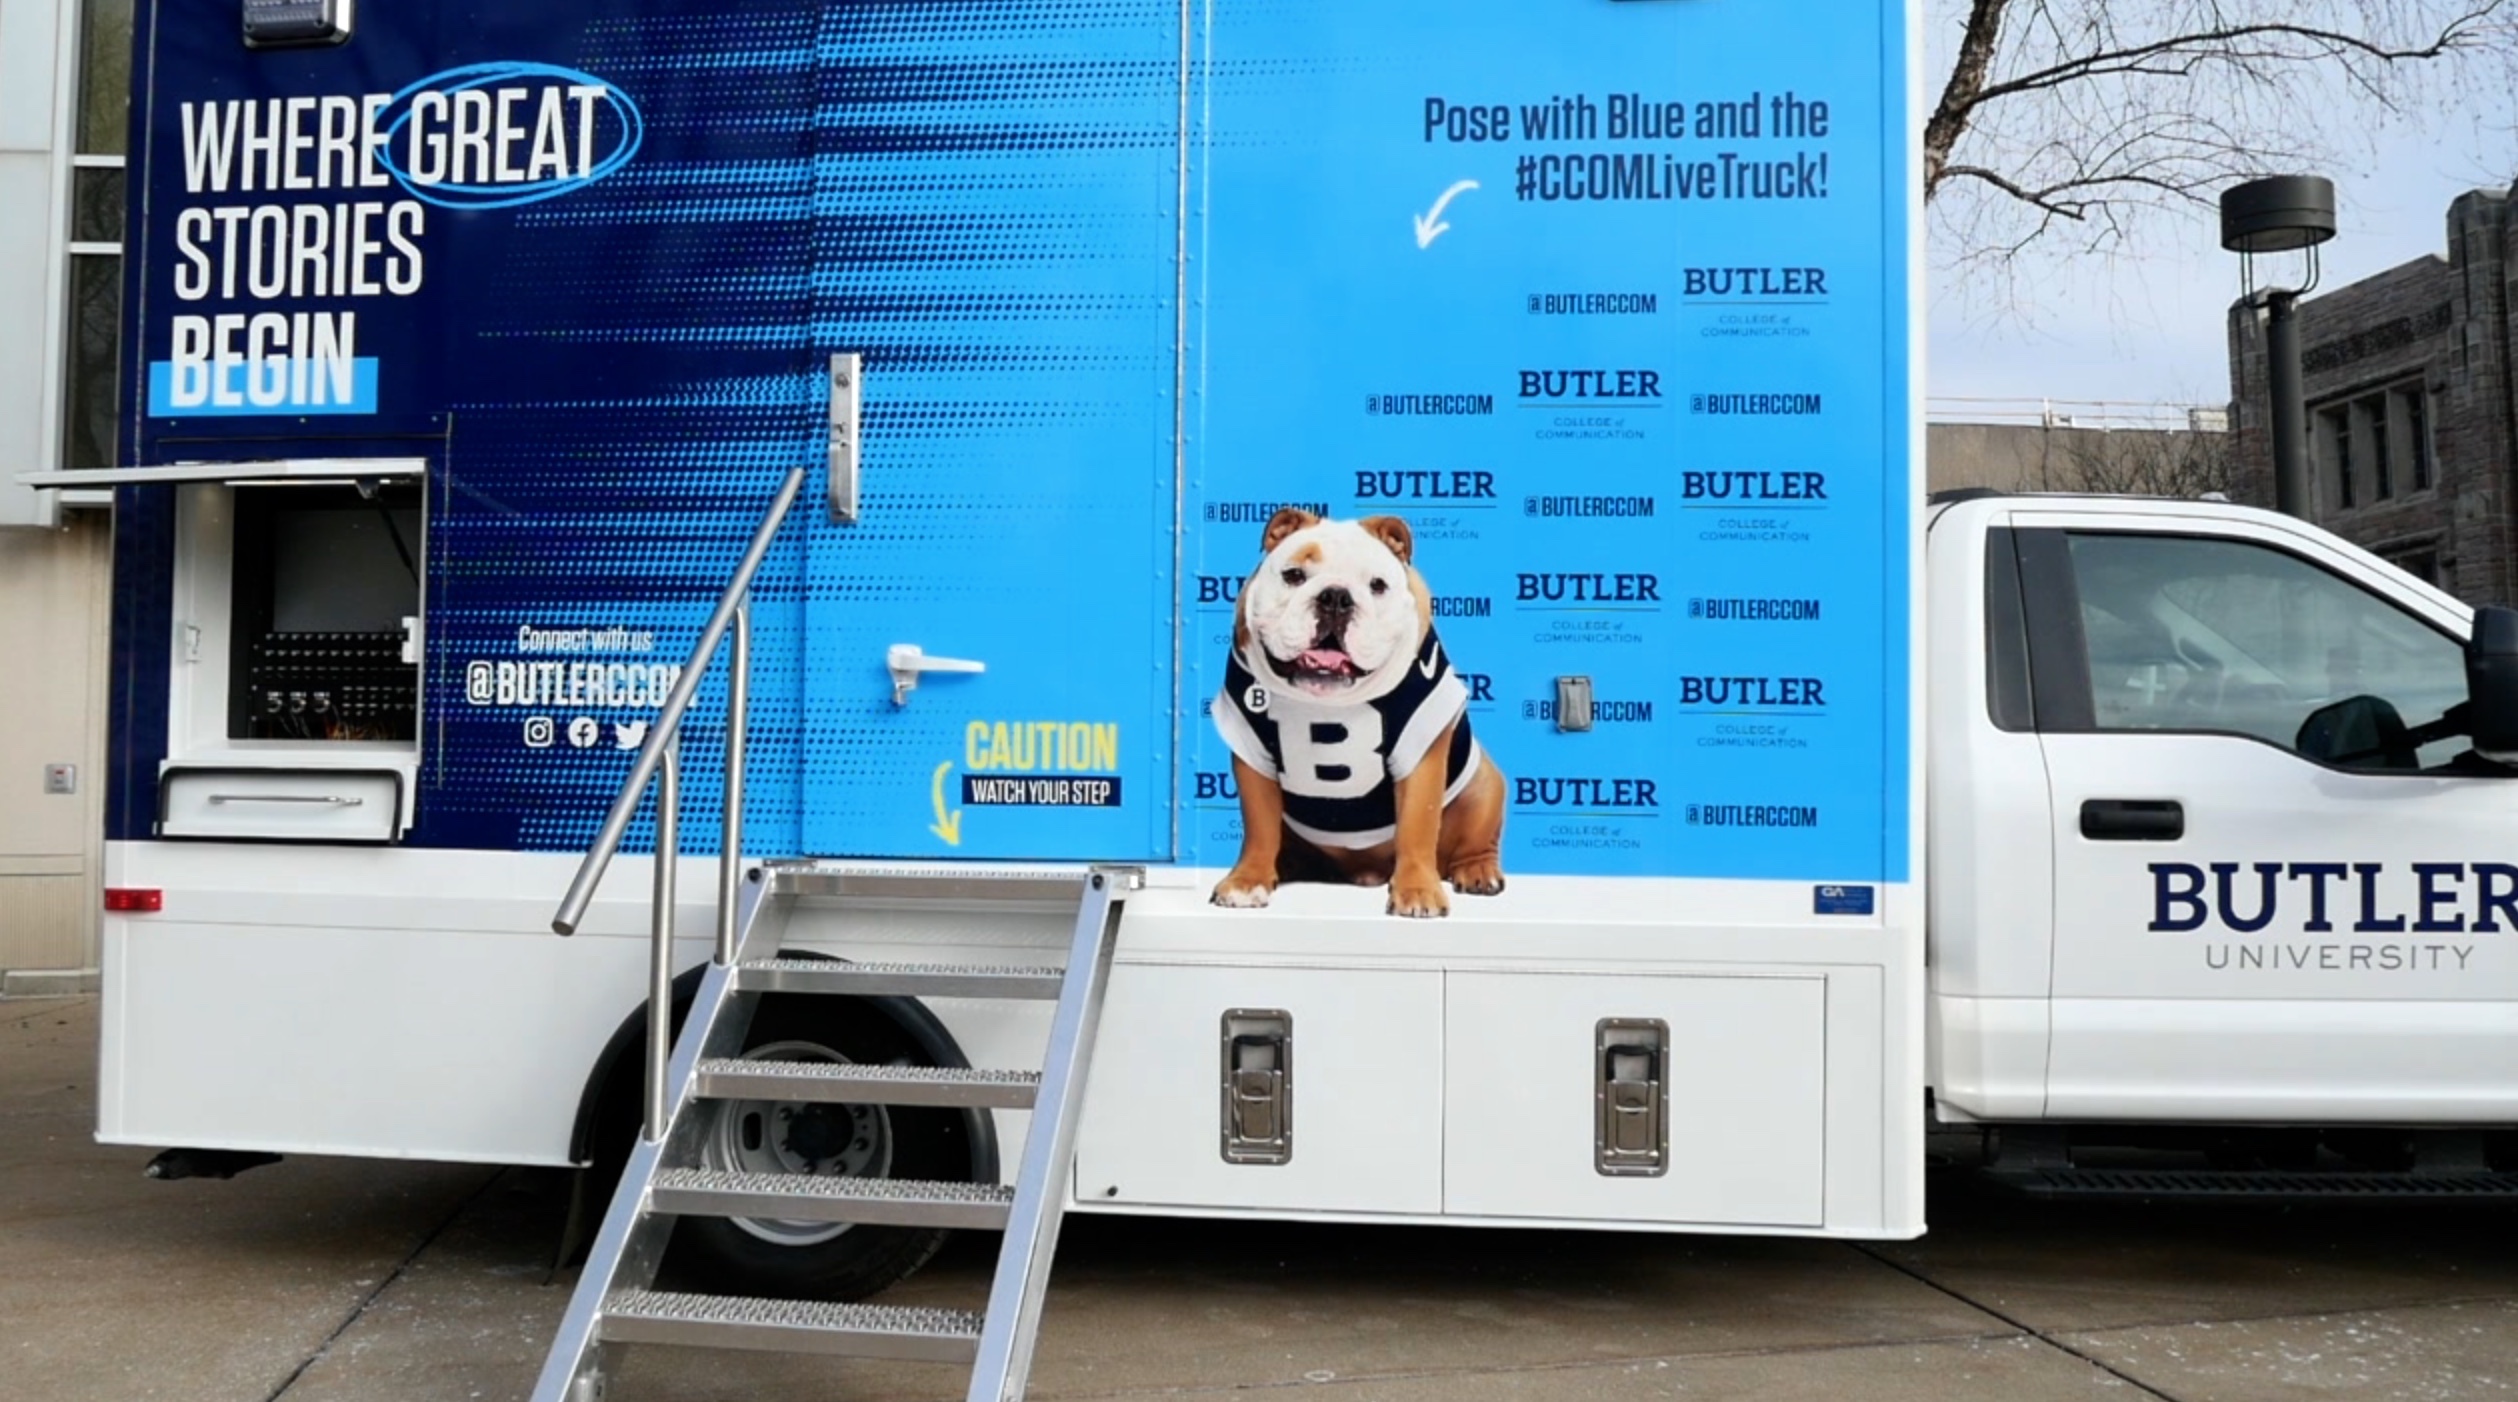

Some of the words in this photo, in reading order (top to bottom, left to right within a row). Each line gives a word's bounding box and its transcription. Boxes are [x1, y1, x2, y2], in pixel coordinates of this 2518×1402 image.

[1425, 97, 1510, 142] Pose
[1520, 95, 1597, 141] with
[1607, 93, 1685, 140] Blue
[1695, 92, 1760, 139] and
[1771, 91, 1828, 138] the
[181, 94, 394, 193] WHERE
[409, 86, 606, 185] GREAT
[1516, 151, 1828, 201] #CCOMLiveTruck!
[174, 201, 425, 300] STORIES
[1684, 268, 1828, 295] BUTLER
[1527, 293, 1657, 315] @BUTLERCCOM
[170, 312, 355, 408] BEGIN
[1518, 370, 1663, 397] BUTLER
[1366, 394, 1493, 415] @BUTLERCCOM
[1690, 394, 1821, 415] @BUTLERCCOM
[1355, 471, 1497, 498] BUTLER
[1682, 471, 1828, 499] BUTLER
[1524, 496, 1654, 517] @BUTLERCCOM
[1516, 574, 1661, 601] BUTLER
[1688, 598, 1820, 621] @BUTLERCCOM
[518, 625, 589, 651] Connect
[591, 626, 627, 651] with
[633, 631, 653, 651] us
[1252, 688, 1266, 707] B
[1679, 677, 1827, 706] BUTLER
[966, 720, 1118, 771] CAUTION
[1268, 698, 1385, 800] B
[971, 779, 1025, 804] WATCH
[1028, 780, 1070, 805] YOUR
[1072, 780, 1111, 805] STEP
[1514, 778, 1659, 806] BUTLER
[1686, 804, 1818, 827] @BUTLERCCOM
[2147, 862, 2518, 933] BUTLER
[2205, 945, 2474, 970] UNIVERSITY
